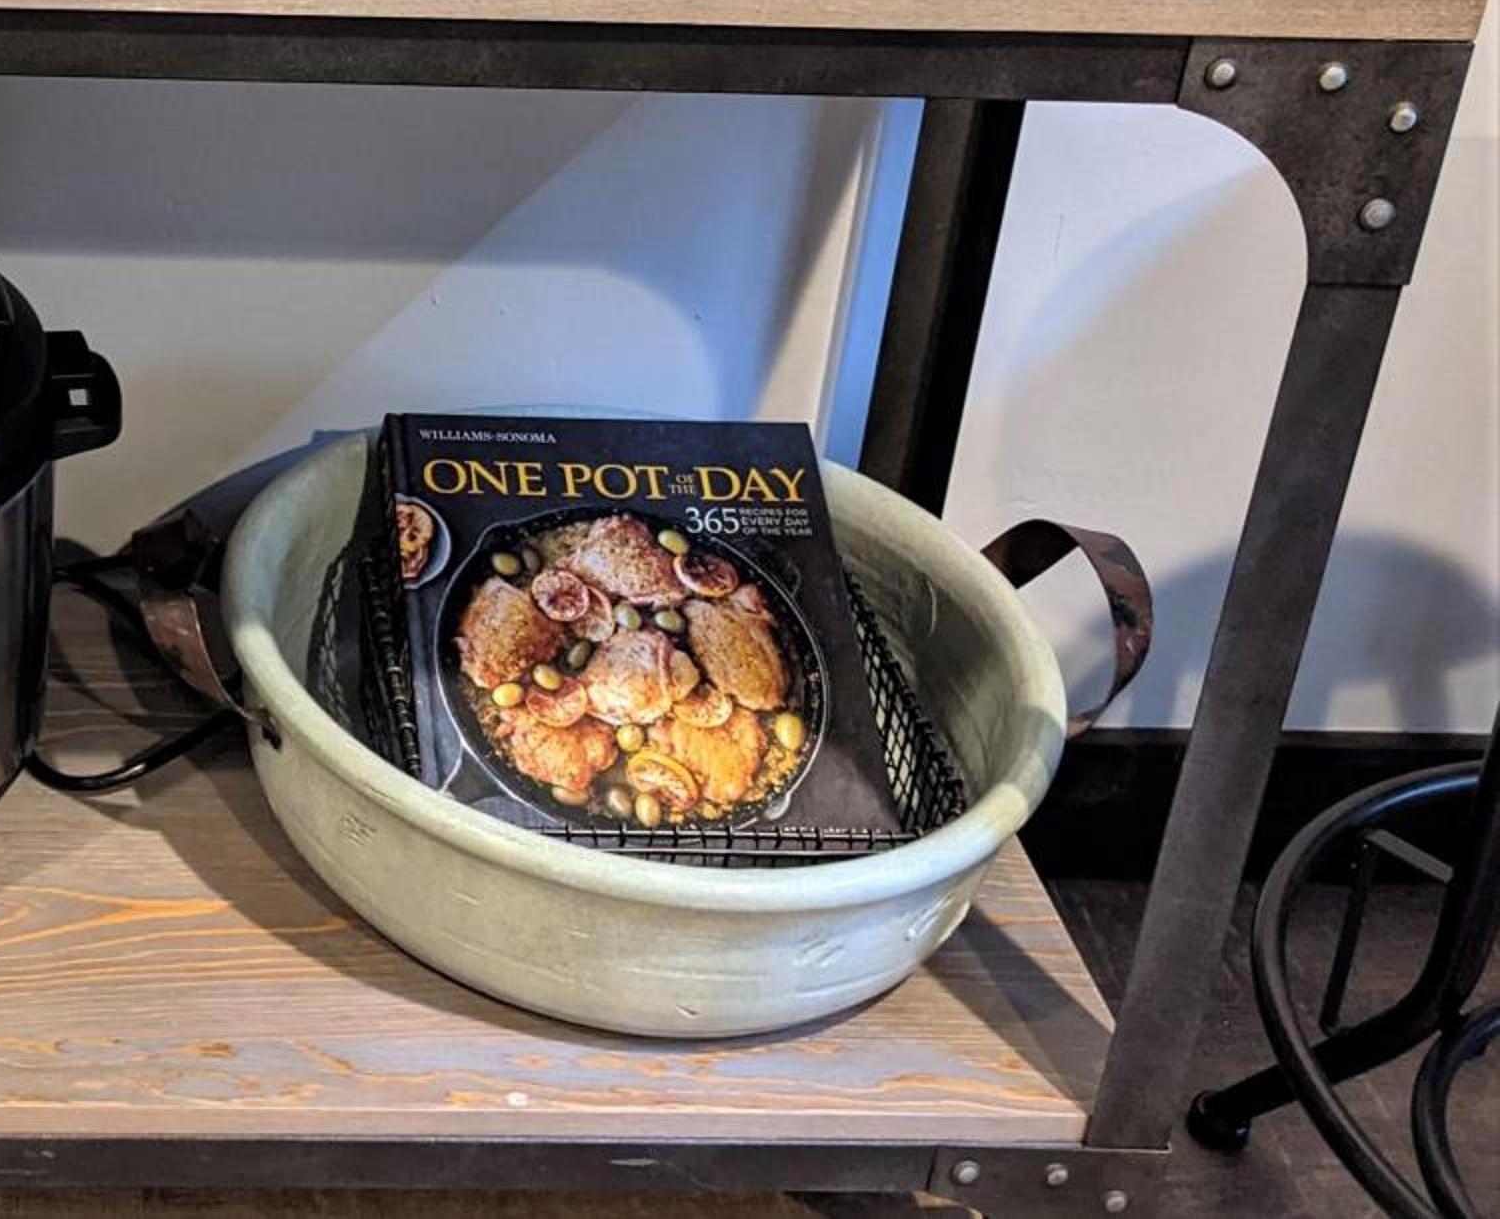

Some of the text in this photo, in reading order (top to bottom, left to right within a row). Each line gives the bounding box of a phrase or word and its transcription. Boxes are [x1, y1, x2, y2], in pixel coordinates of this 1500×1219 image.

[419, 428, 557, 444] WILLIAMS-SONOMA
[423, 458, 669, 500] ONE POT
[676, 473, 695, 484] OF
[693, 466, 805, 502] DAY
[669, 484, 697, 496] THE
[739, 508, 808, 516] RECIPES FOR
[685, 506, 740, 534] 365
[741, 516, 809, 526] EVERY DAY
[742, 526, 813, 537] OF THE YEAR
